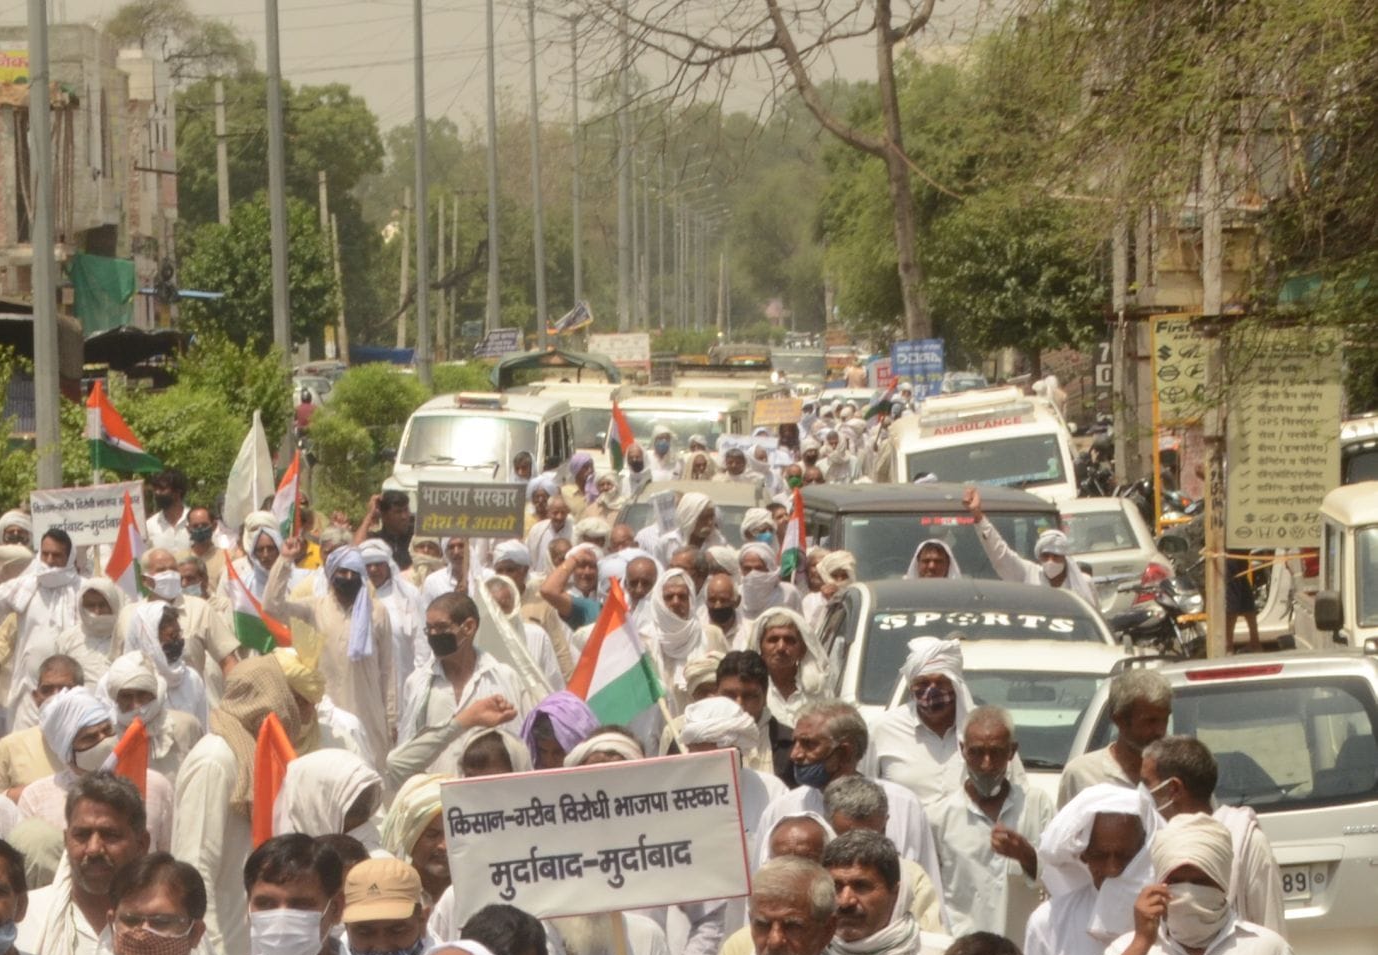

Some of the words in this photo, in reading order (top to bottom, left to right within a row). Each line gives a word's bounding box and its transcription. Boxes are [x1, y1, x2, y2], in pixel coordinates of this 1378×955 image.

[933, 416, 1023, 436] AMBULANCE
[423, 486, 470, 507] भाजपा
[473, 487, 518, 508] सरकार
[447, 795, 557, 838] किसान-गरीब
[559, 789, 611, 825] विरोधी
[614, 791, 669, 818] भाजपा
[671, 783, 730, 811] सरकार
[489, 834, 692, 901] मुर्दाबाद-मुर्दाबाद
